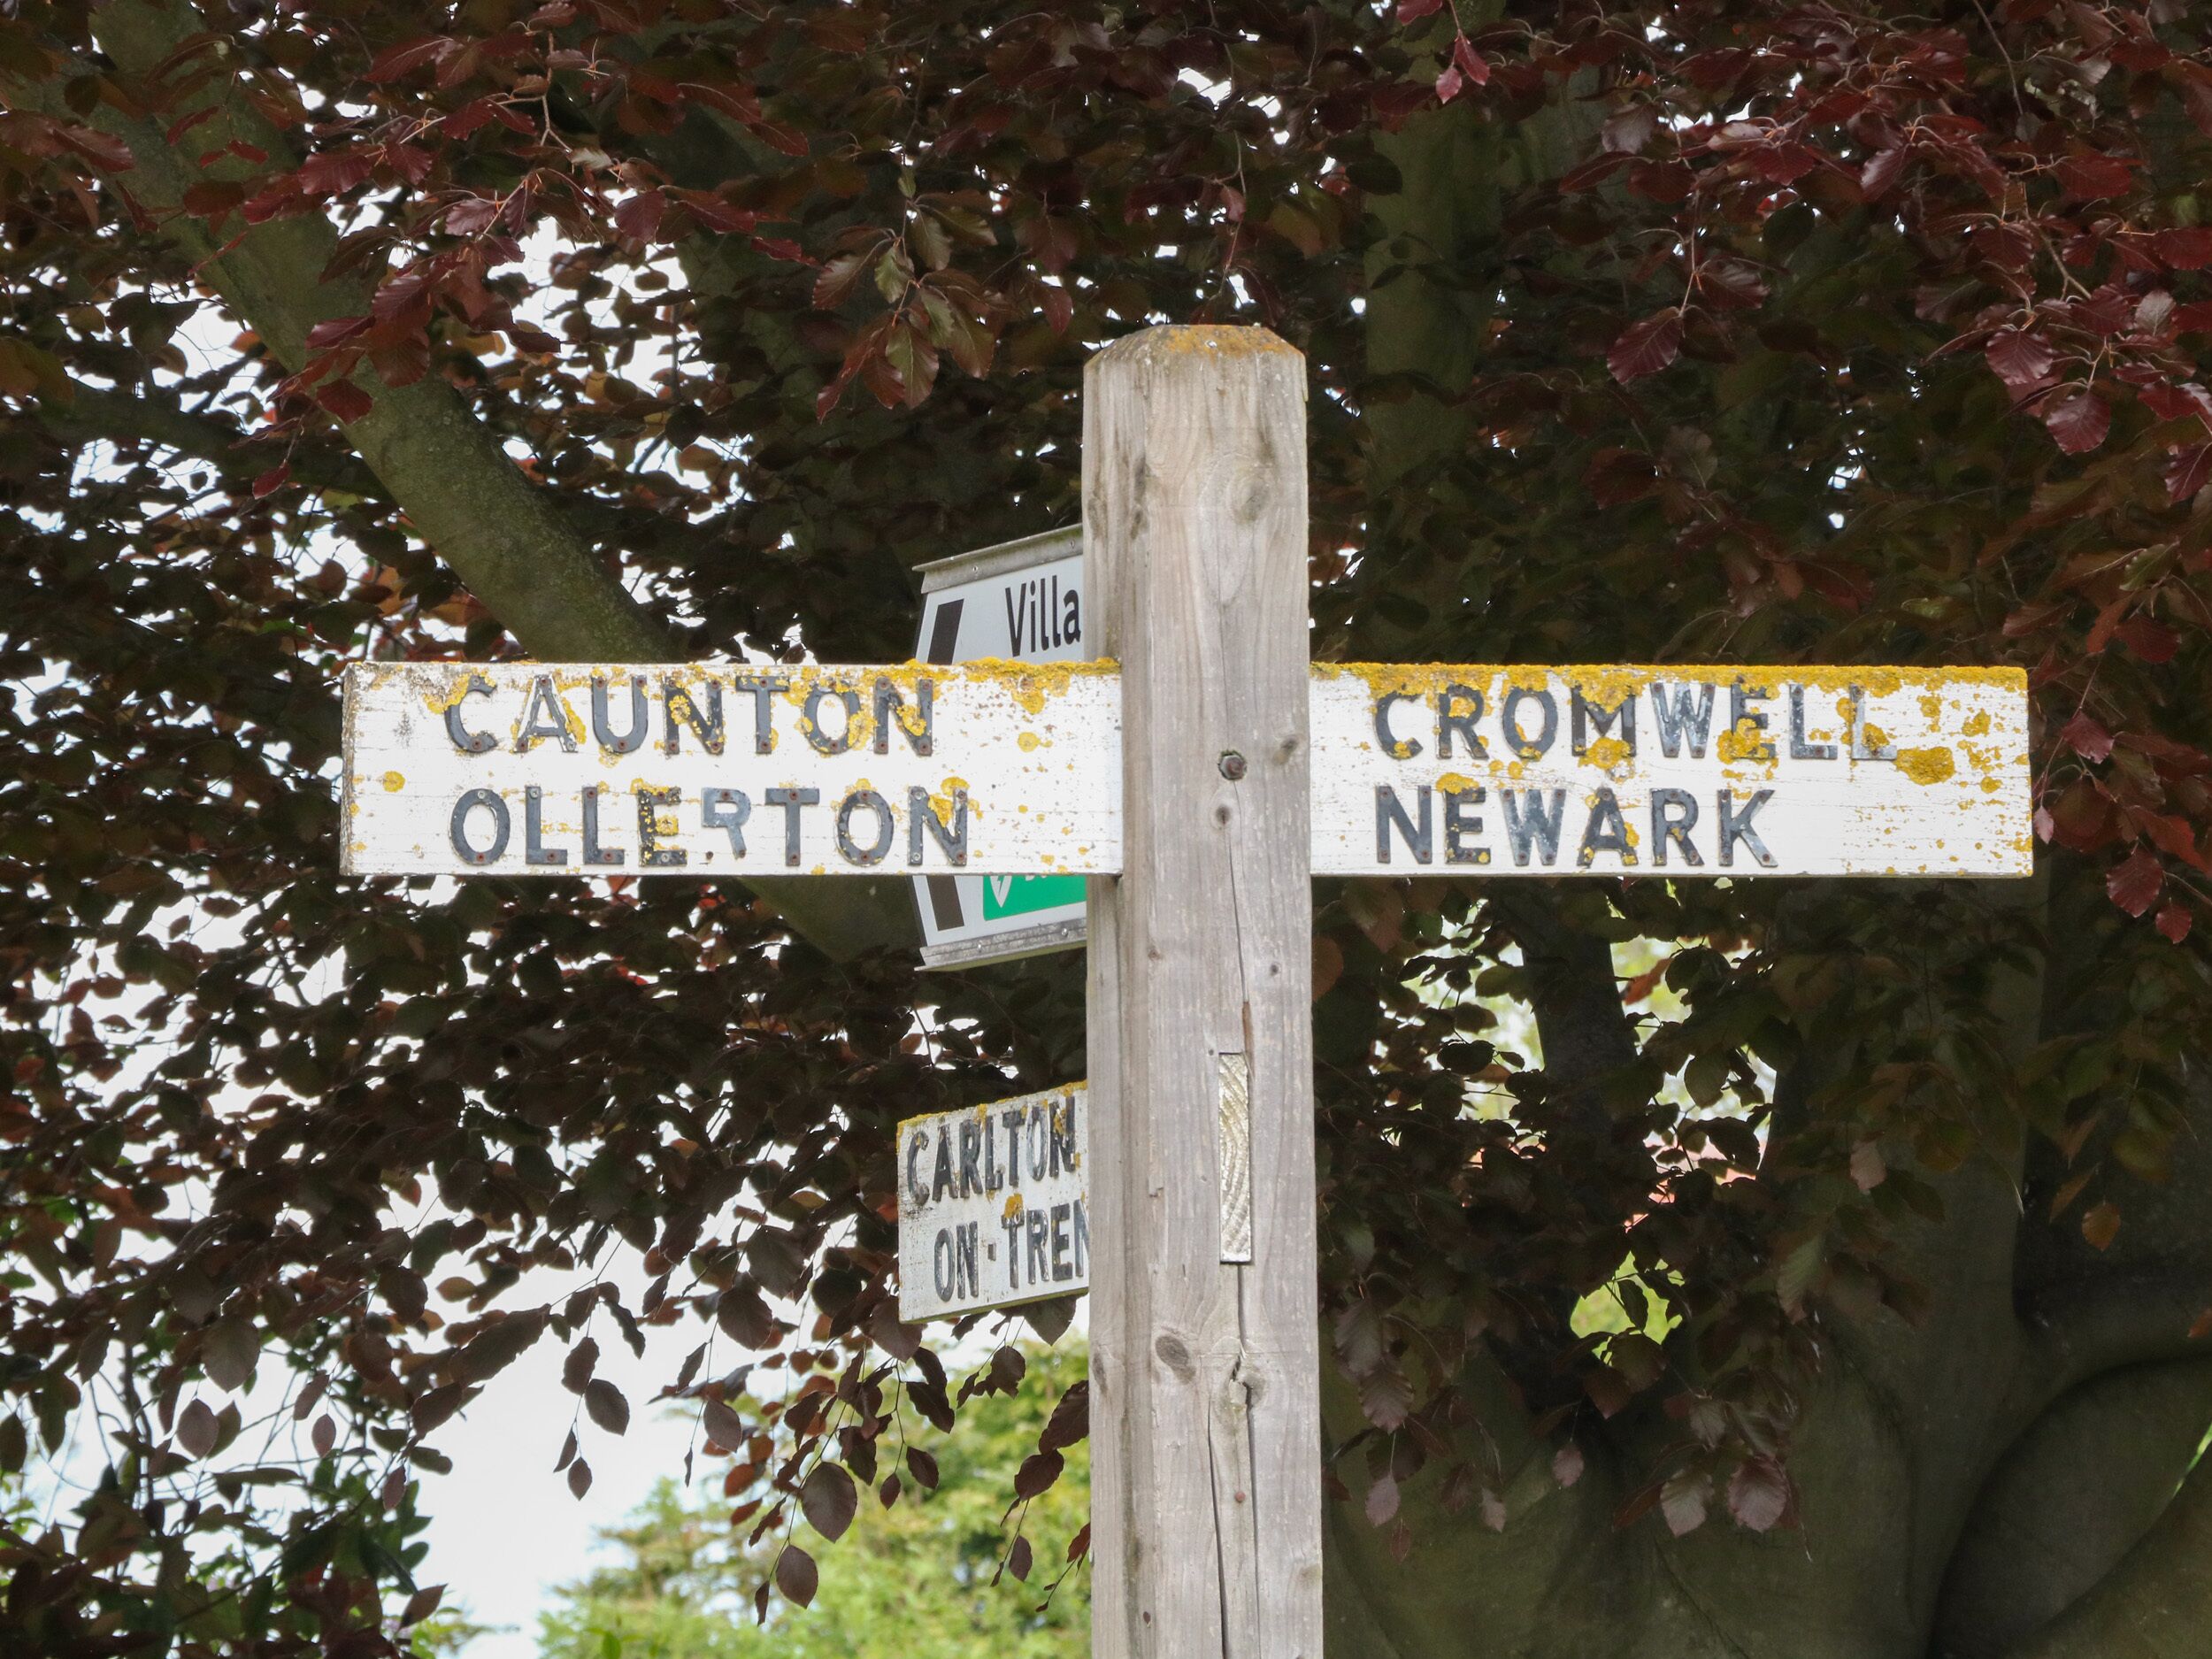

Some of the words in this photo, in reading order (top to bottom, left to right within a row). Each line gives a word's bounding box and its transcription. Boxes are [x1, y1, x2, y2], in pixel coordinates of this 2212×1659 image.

[1004, 574, 1081, 658] Villa
[444, 674, 933, 756] CAUNTON
[1372, 676, 1897, 762] CROMWELL
[449, 784, 968, 868] OLLERTON
[1375, 784, 1778, 868] NEWARK
[906, 1095, 1077, 1206] CARLTON
